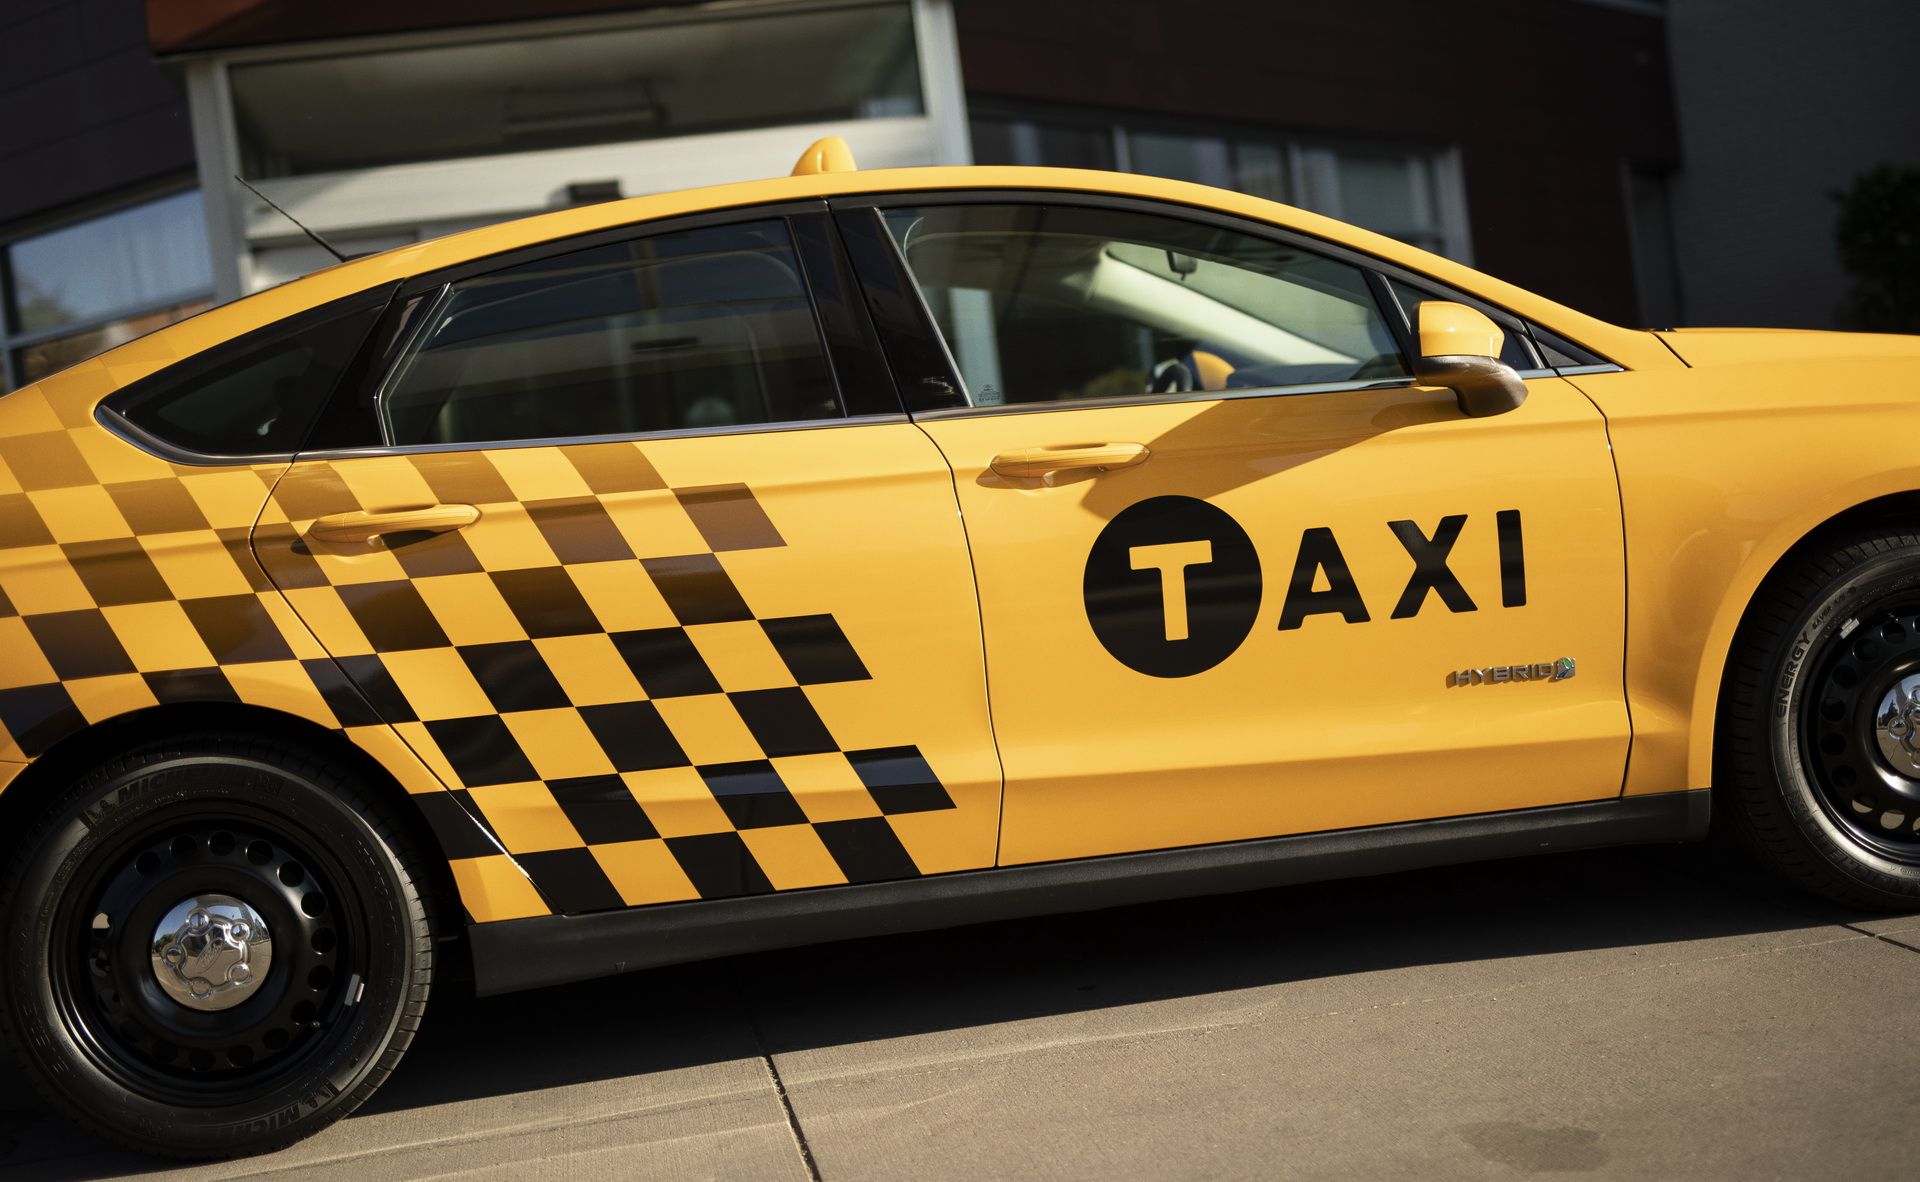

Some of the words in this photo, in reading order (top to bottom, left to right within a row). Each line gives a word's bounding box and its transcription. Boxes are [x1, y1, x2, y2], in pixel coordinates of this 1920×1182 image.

[1128, 509, 1527, 642] TAXI
[1455, 662, 1555, 687] HYBRID
[1775, 630, 1811, 718] ENERGY
